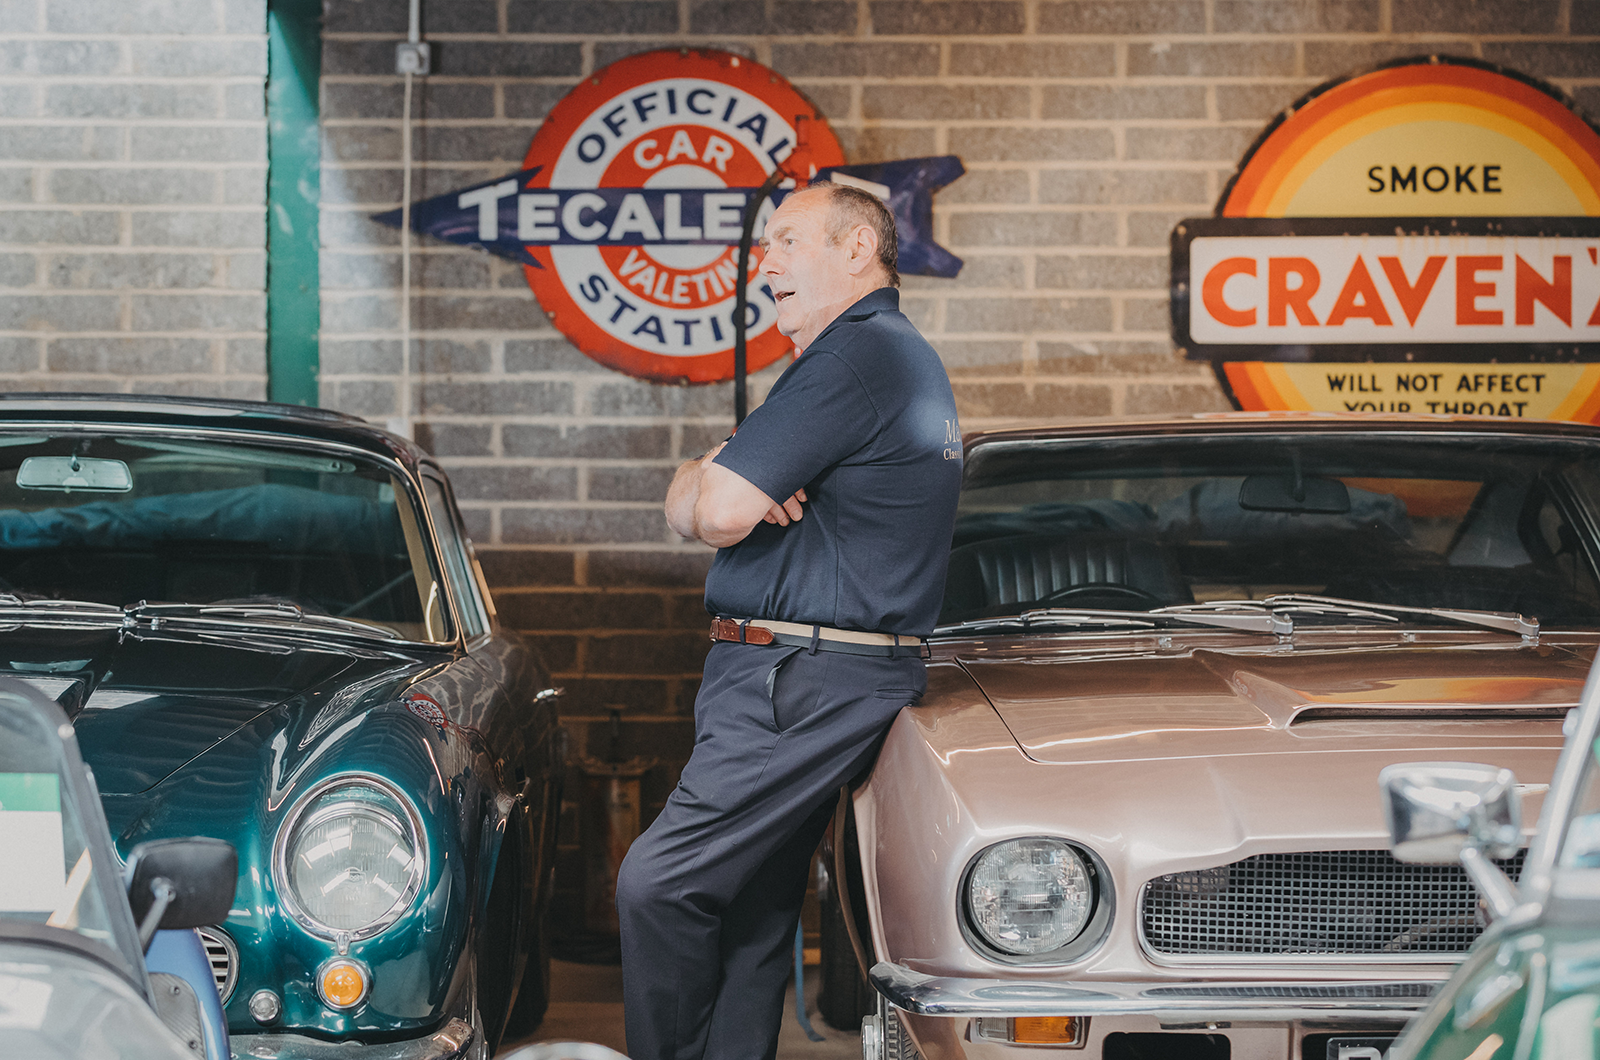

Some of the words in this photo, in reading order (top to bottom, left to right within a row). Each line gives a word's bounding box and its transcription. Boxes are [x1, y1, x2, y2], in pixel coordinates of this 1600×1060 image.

[577, 87, 789, 167] OFFICIAL
[633, 130, 734, 173] CAR
[1368, 165, 1502, 193] SMOKE
[579, 274, 776, 346] STATIO
[1327, 374, 1382, 392] WILL
[1397, 374, 1443, 392] NOT
[1457, 374, 1546, 392] AFFECT
[1426, 402, 1528, 417] THROAT
